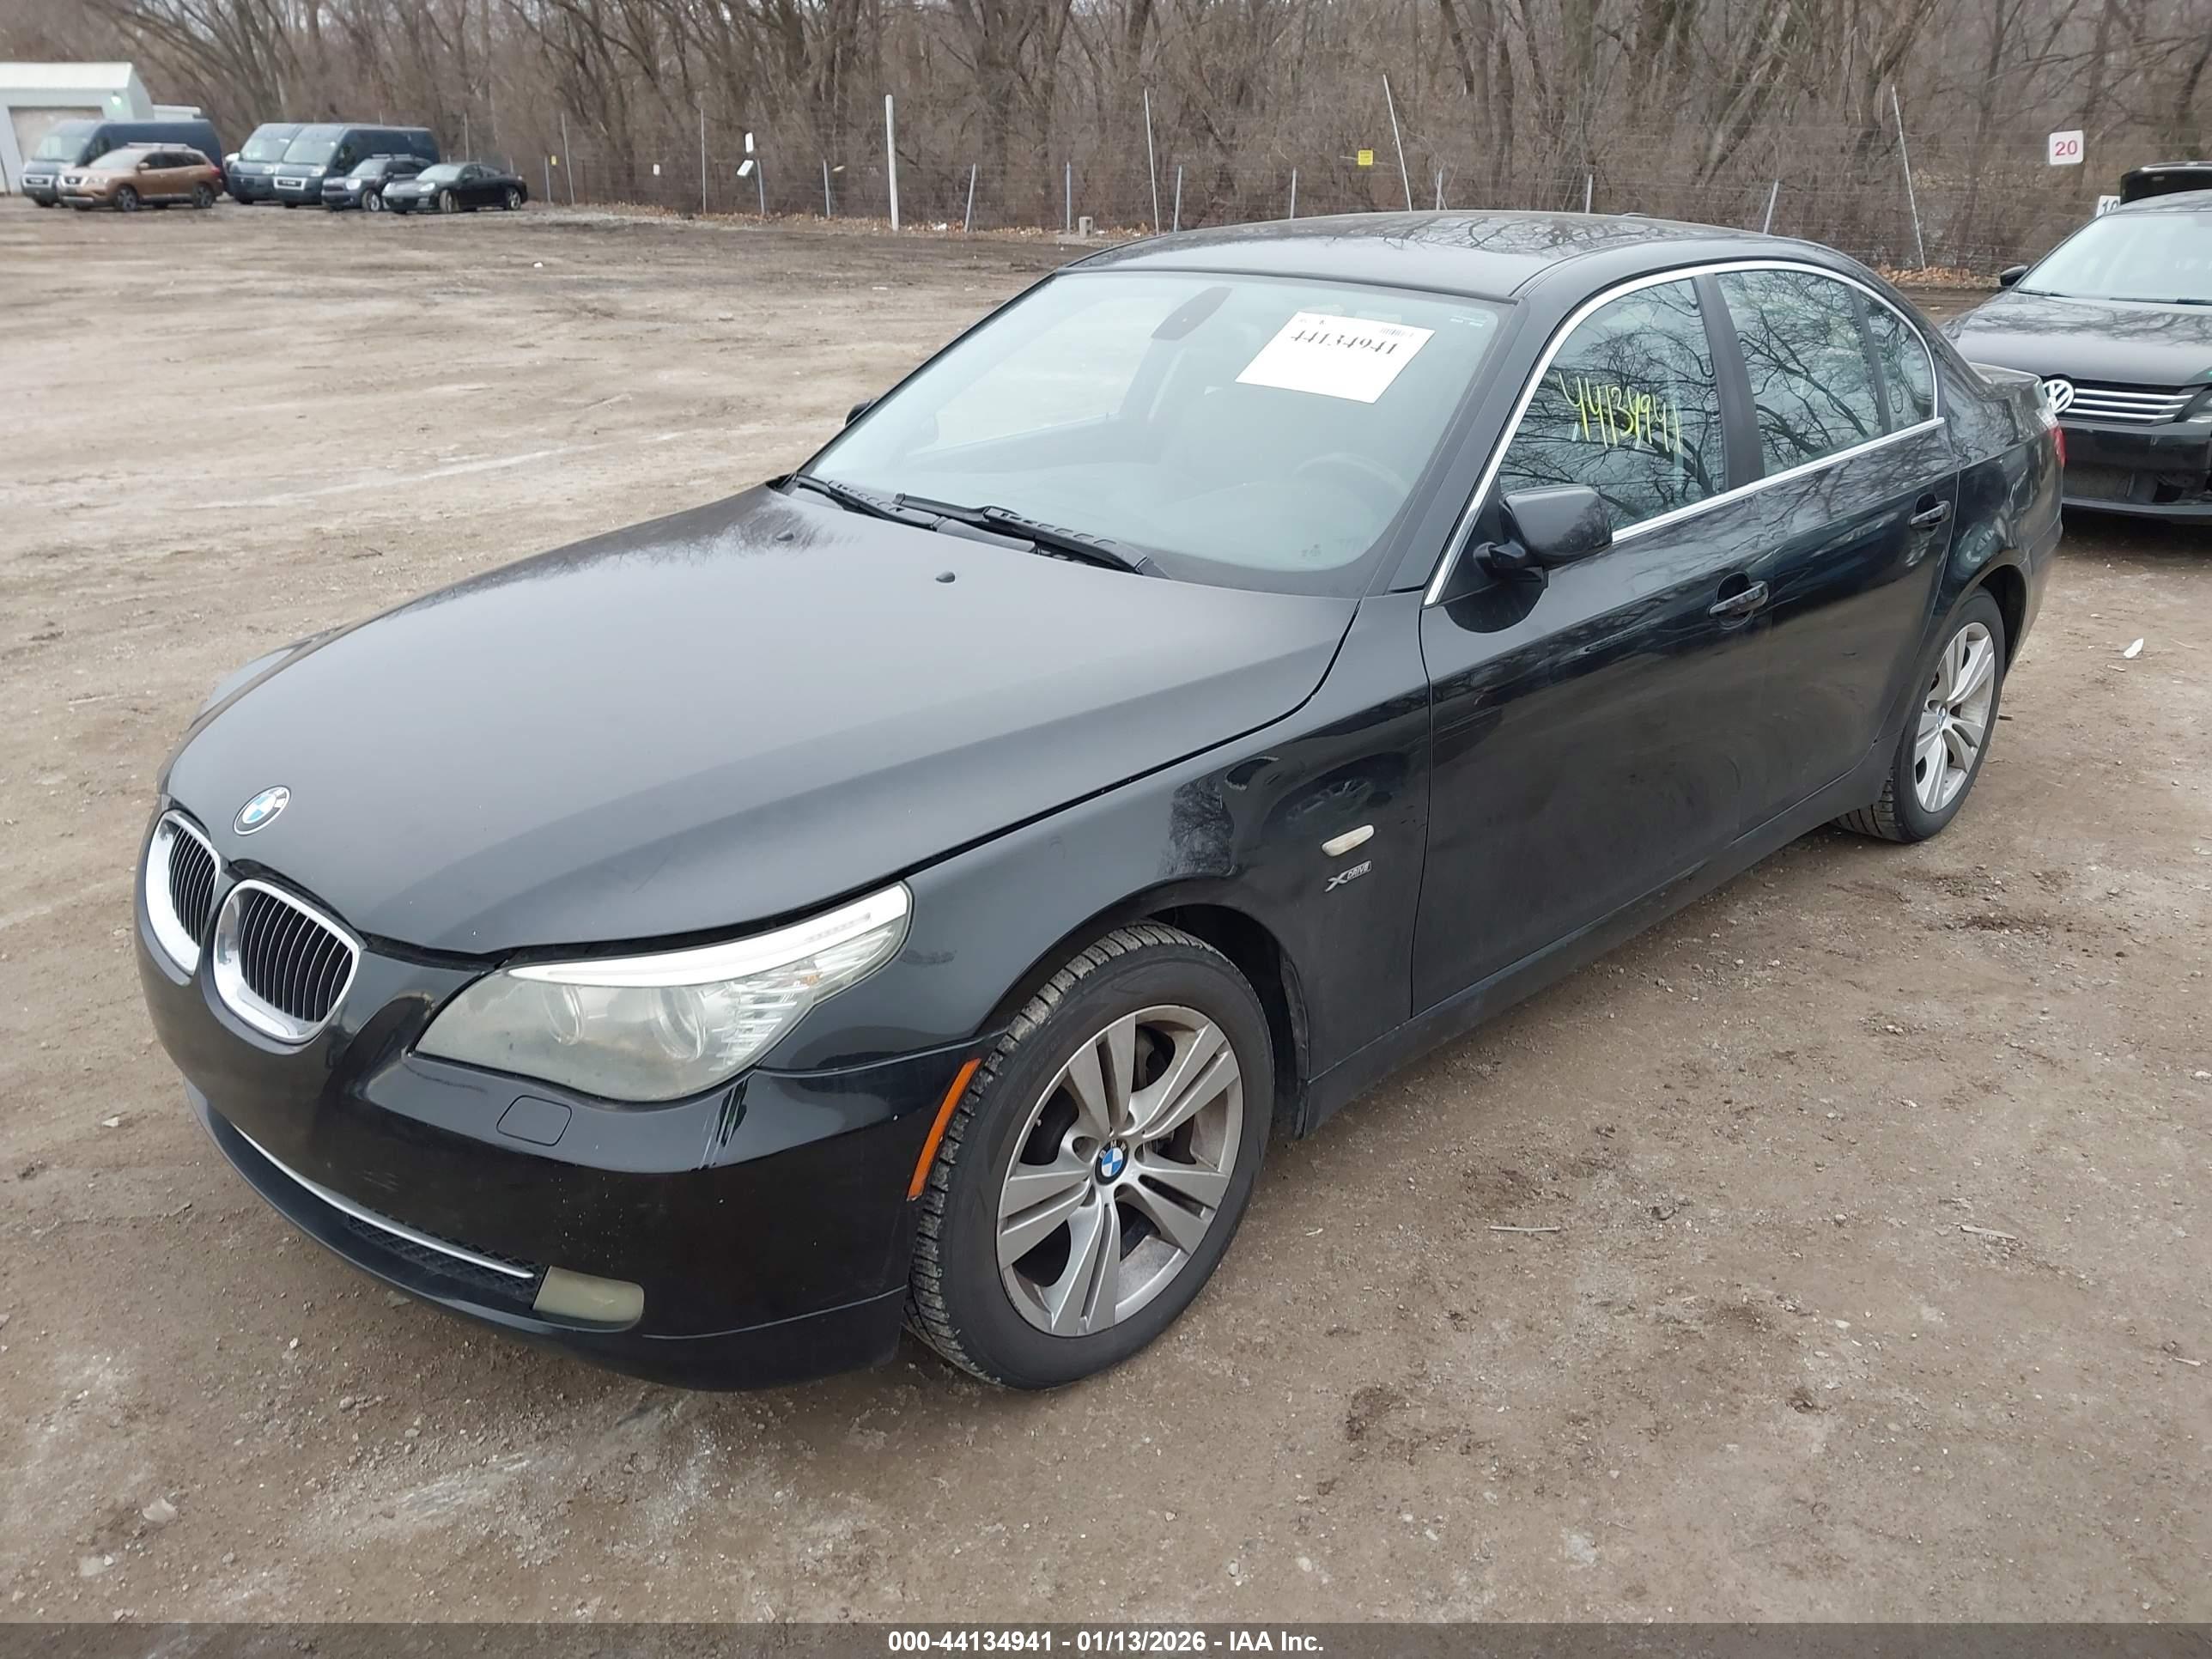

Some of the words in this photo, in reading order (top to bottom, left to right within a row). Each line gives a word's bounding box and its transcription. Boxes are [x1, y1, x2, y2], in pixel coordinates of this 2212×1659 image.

[2055, 140, 2078, 156] 20
[1291, 330, 1399, 355] 44134941
[1559, 372, 1681, 454] 44134941
